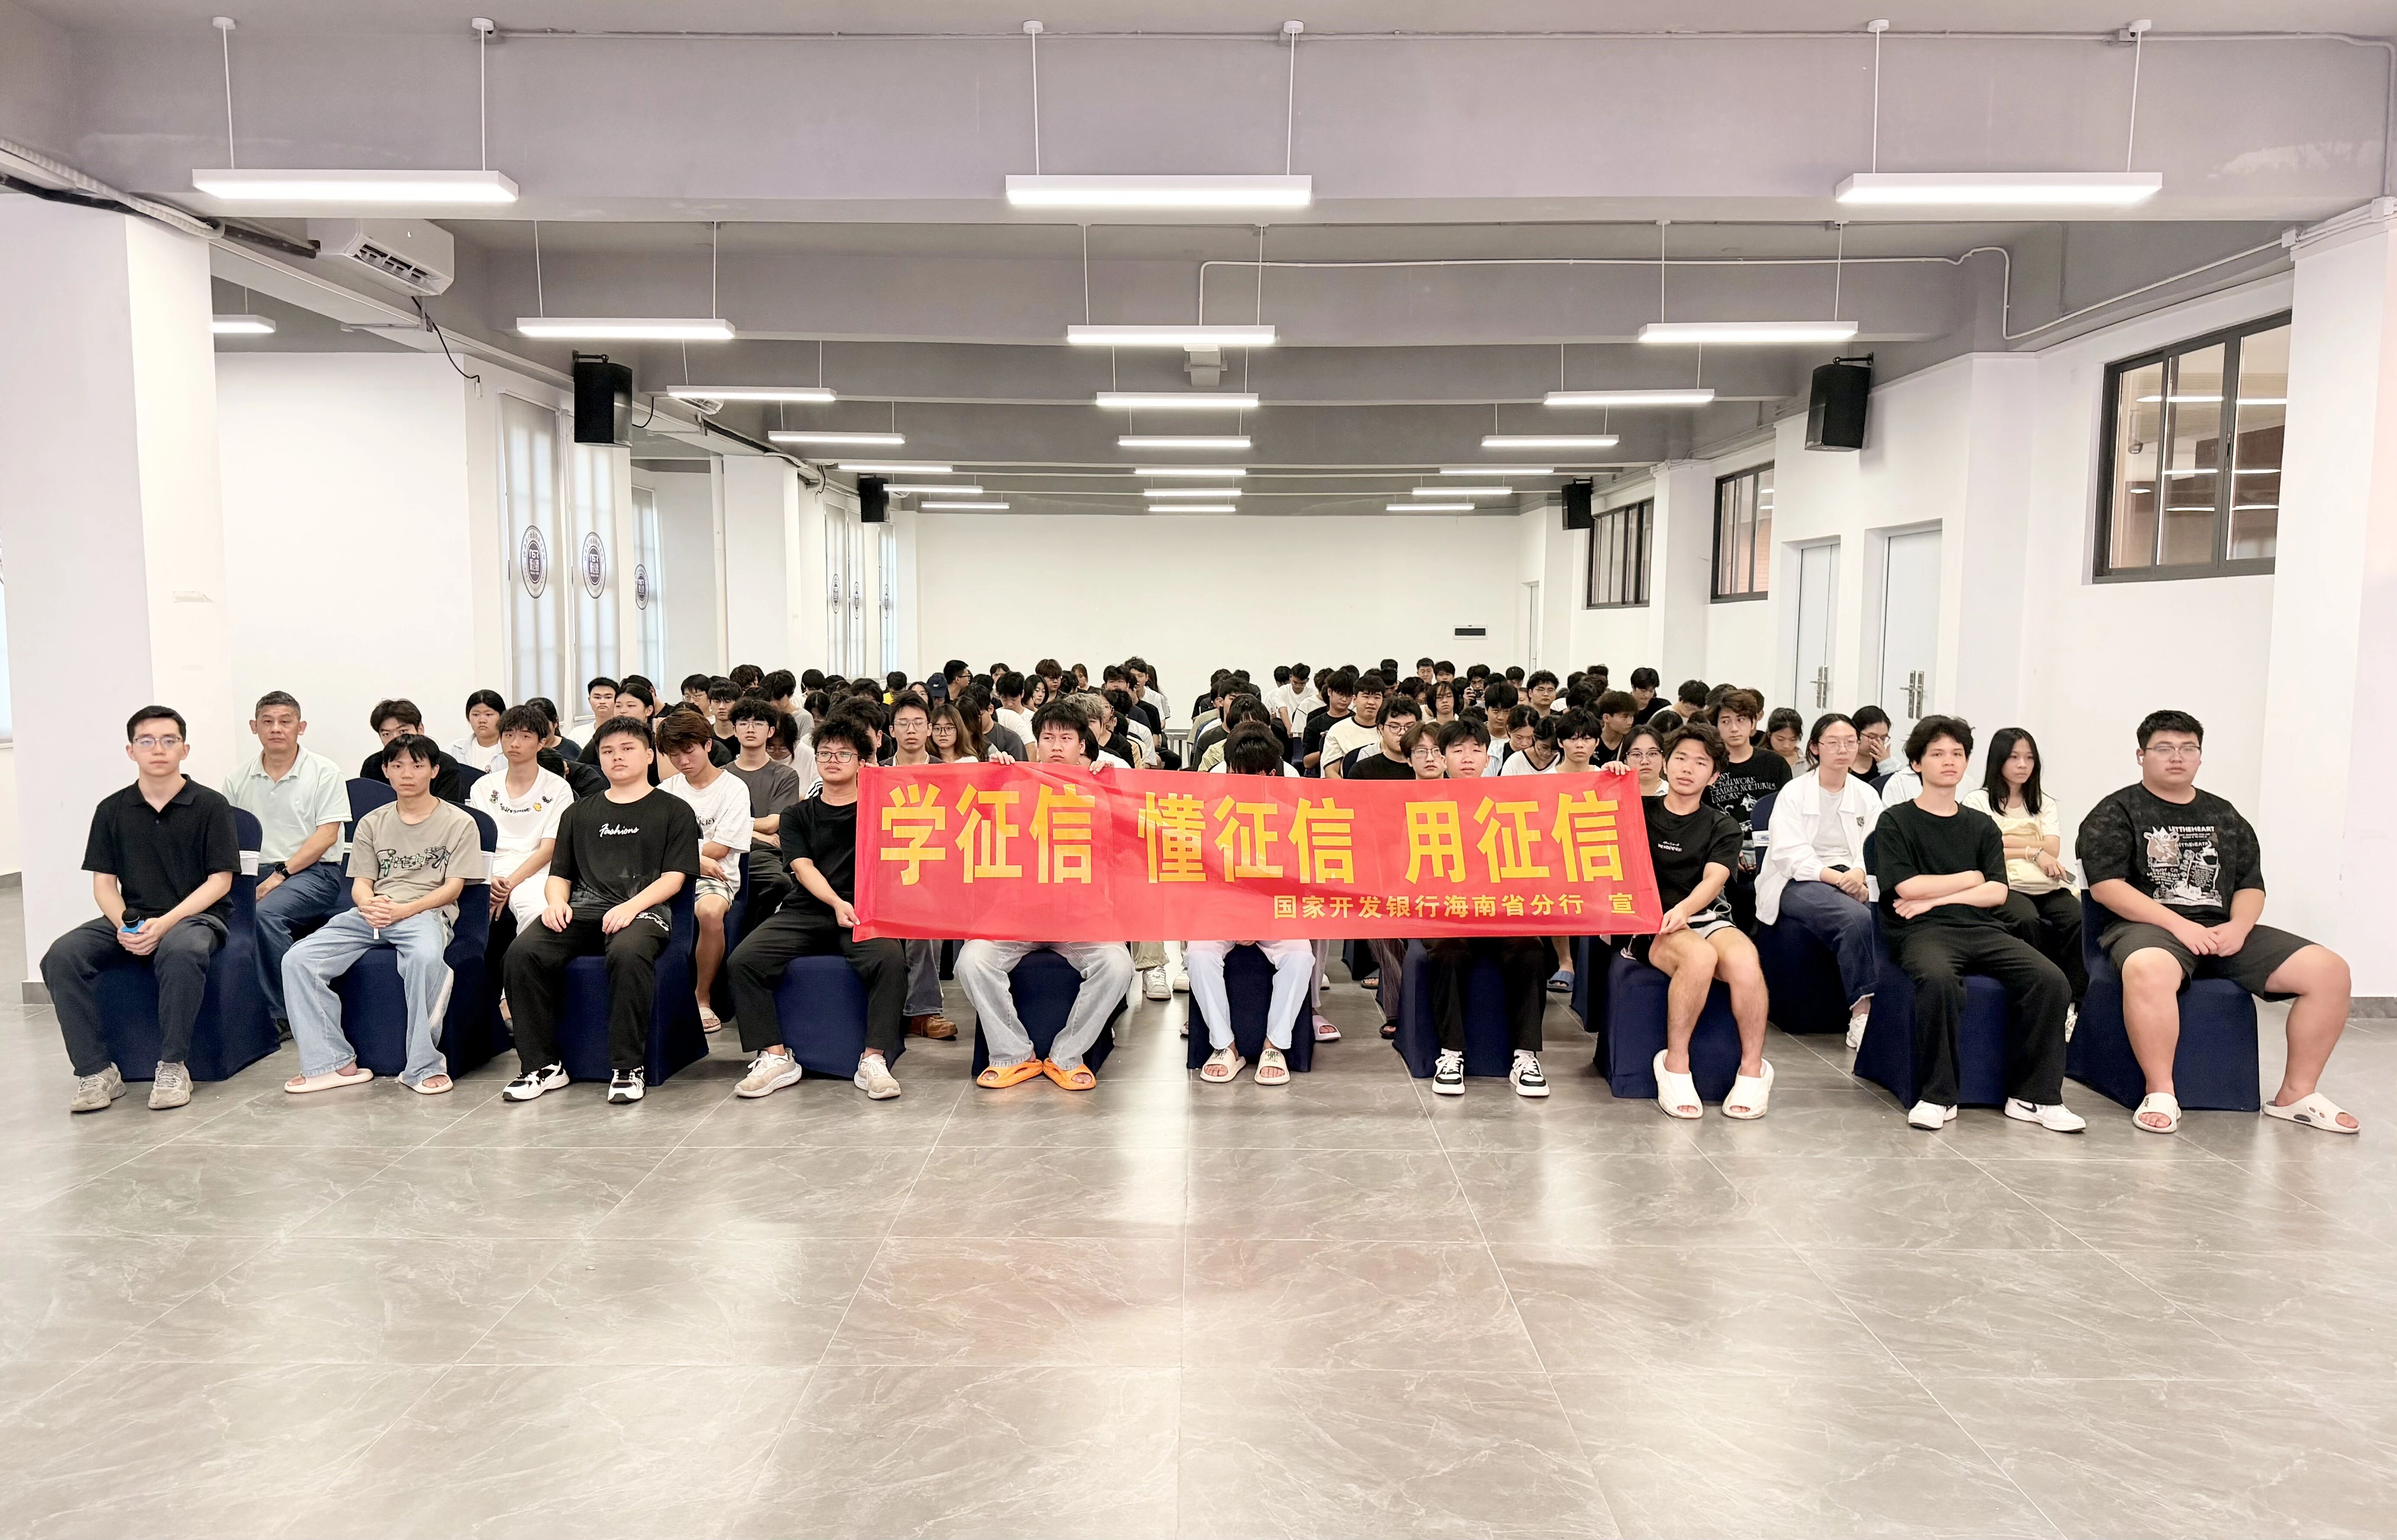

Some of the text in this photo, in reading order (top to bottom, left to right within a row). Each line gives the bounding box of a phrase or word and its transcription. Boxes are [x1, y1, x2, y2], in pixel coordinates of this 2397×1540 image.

[599, 823, 639, 837] Fashions
[880, 784, 1623, 885] 学征信 懂征信 用征信
[1274, 893, 1635, 919] 国家开发银行海南省分行 宣
